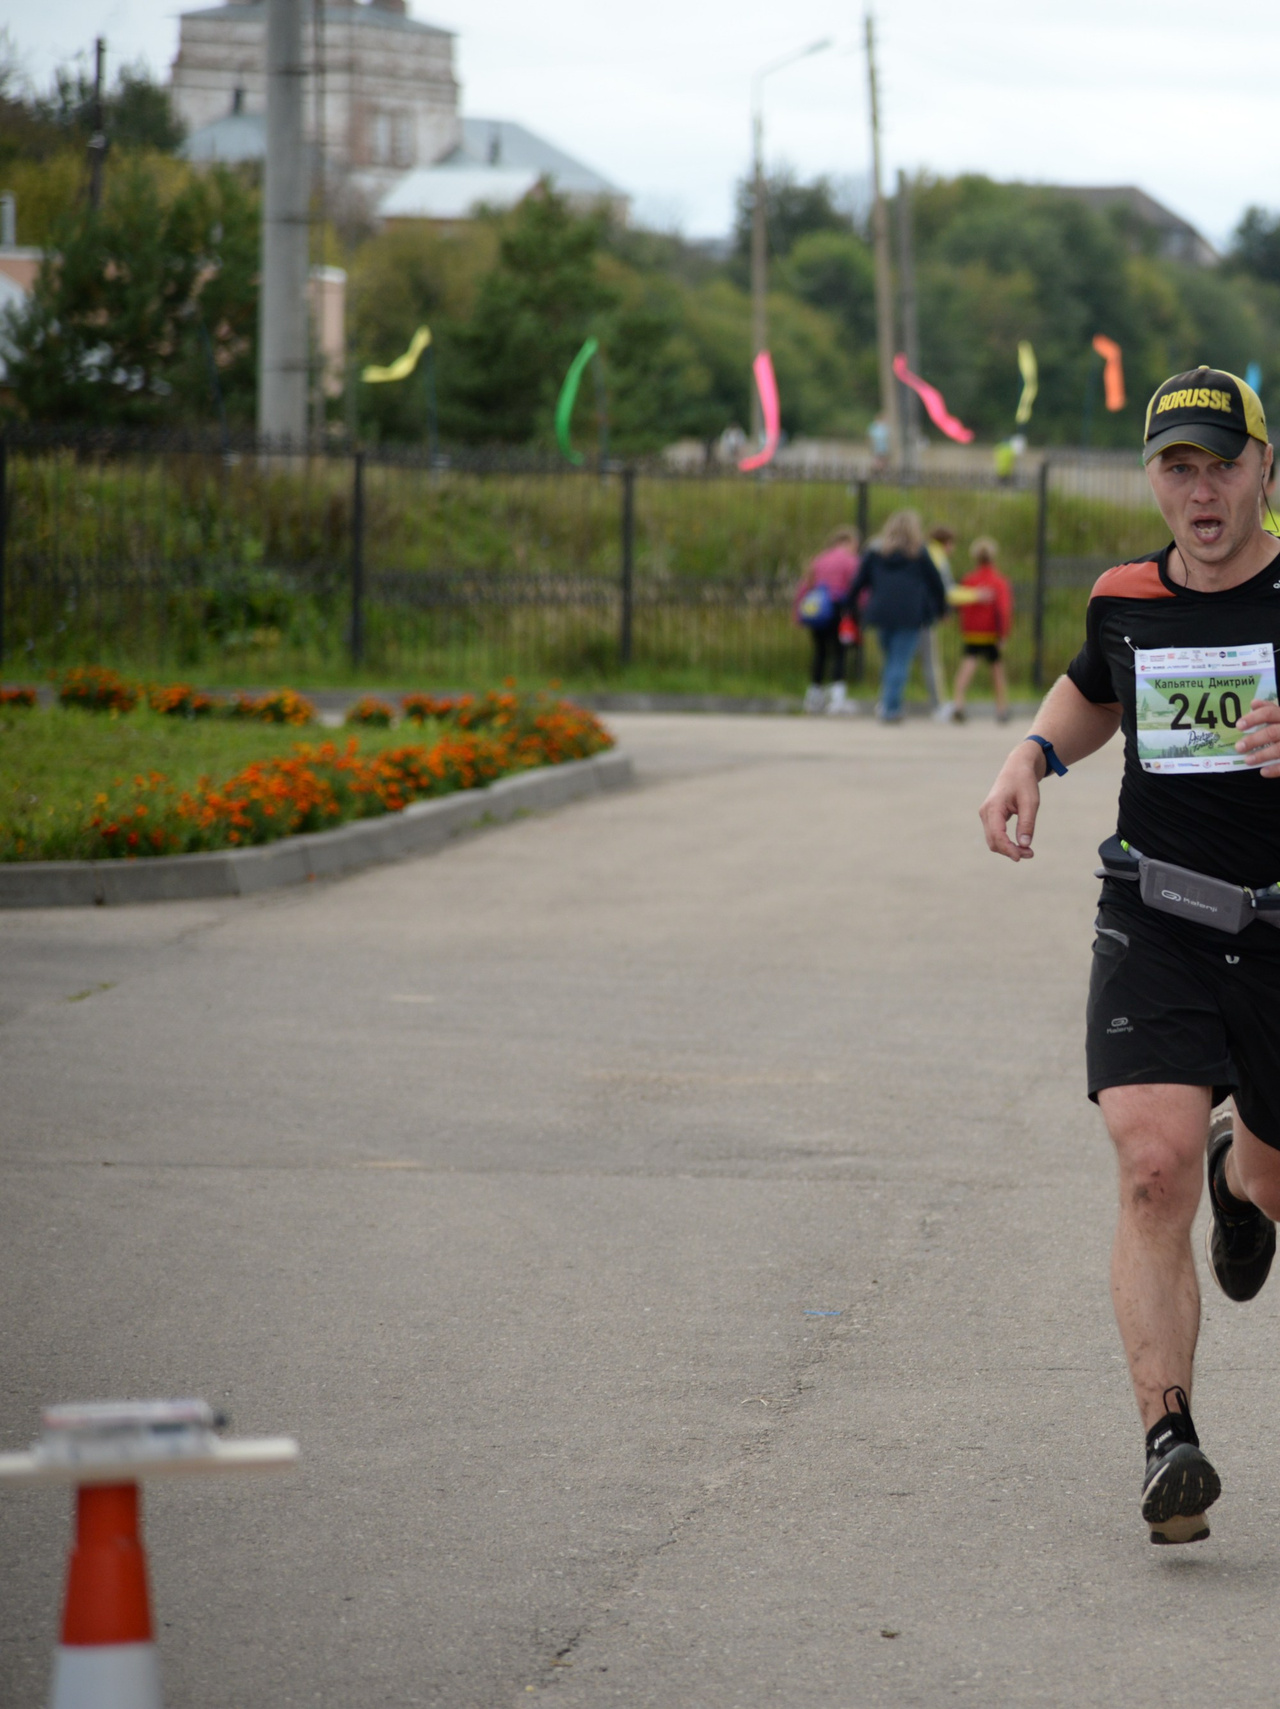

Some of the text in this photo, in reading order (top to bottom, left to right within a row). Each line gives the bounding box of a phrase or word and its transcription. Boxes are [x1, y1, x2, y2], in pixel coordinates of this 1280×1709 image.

[1156, 388, 1231, 414] BORUSSE
[1155, 676, 1255, 689] Капьятец Дмитрий
[1168, 691, 1242, 730] 240
